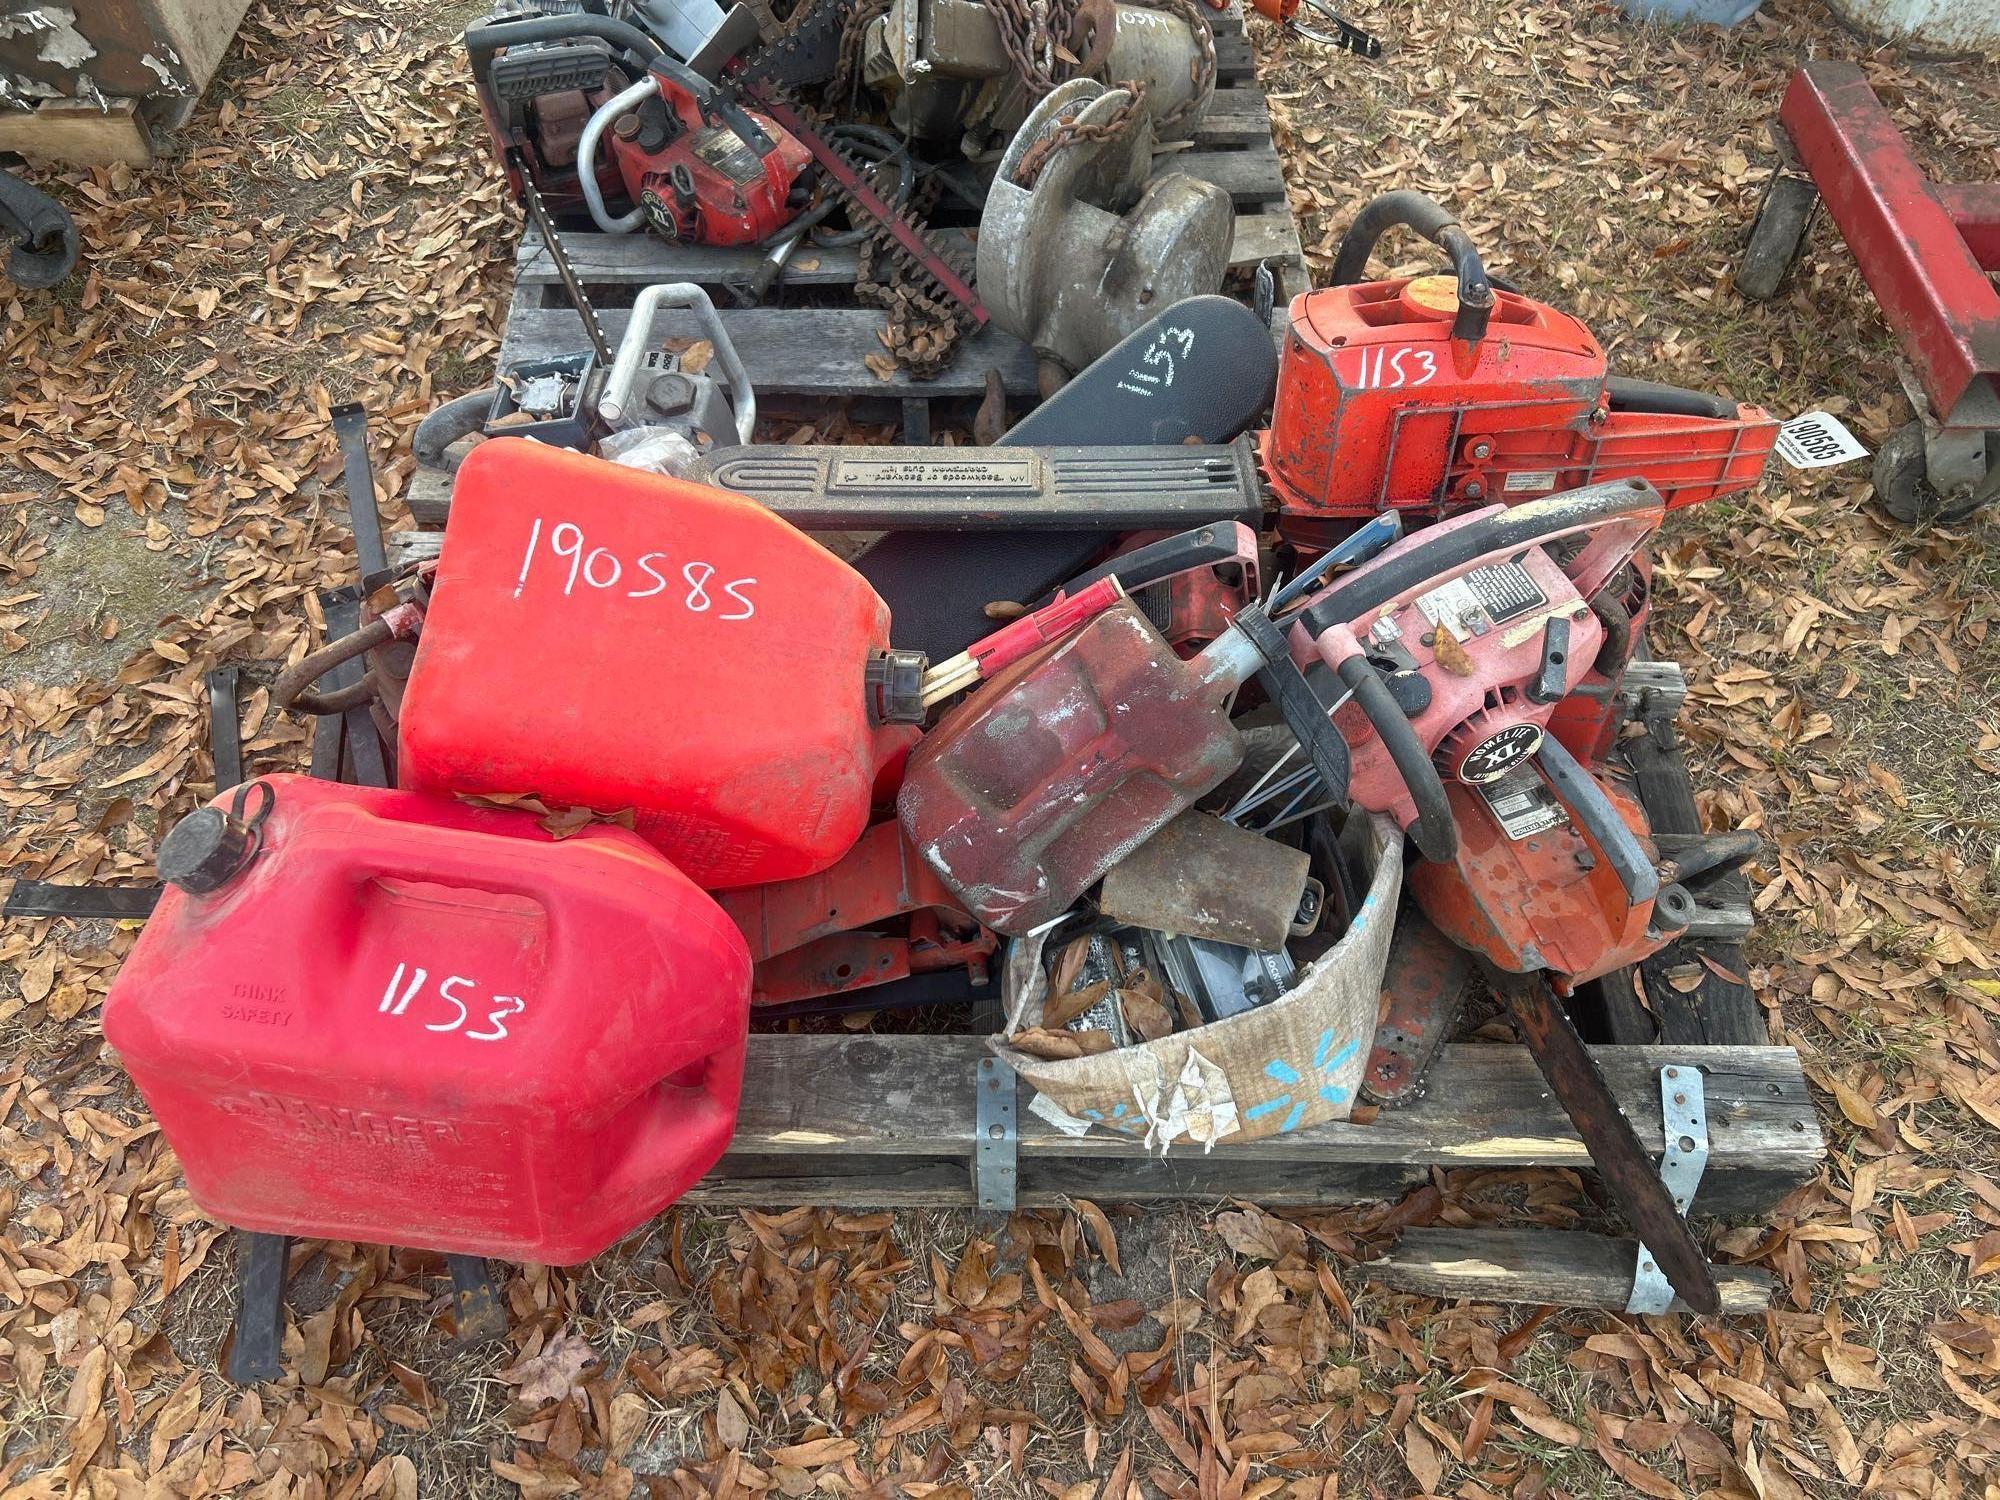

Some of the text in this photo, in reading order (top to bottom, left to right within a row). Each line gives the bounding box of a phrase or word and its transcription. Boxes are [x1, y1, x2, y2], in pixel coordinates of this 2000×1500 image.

[1116, 326, 1195, 397] 1153
[1358, 346, 1437, 390] 1153
[1782, 419, 1847, 460] 190585
[512, 518, 758, 621] 190585
[1468, 727, 1531, 762] HOMELITE
[1485, 740, 1520, 770] XL
[231, 983, 287, 1003] THINK
[1266, 955, 1287, 996] LOCKING
[221, 1002, 294, 1027] SAFETY
[377, 962, 526, 1041] 1153
